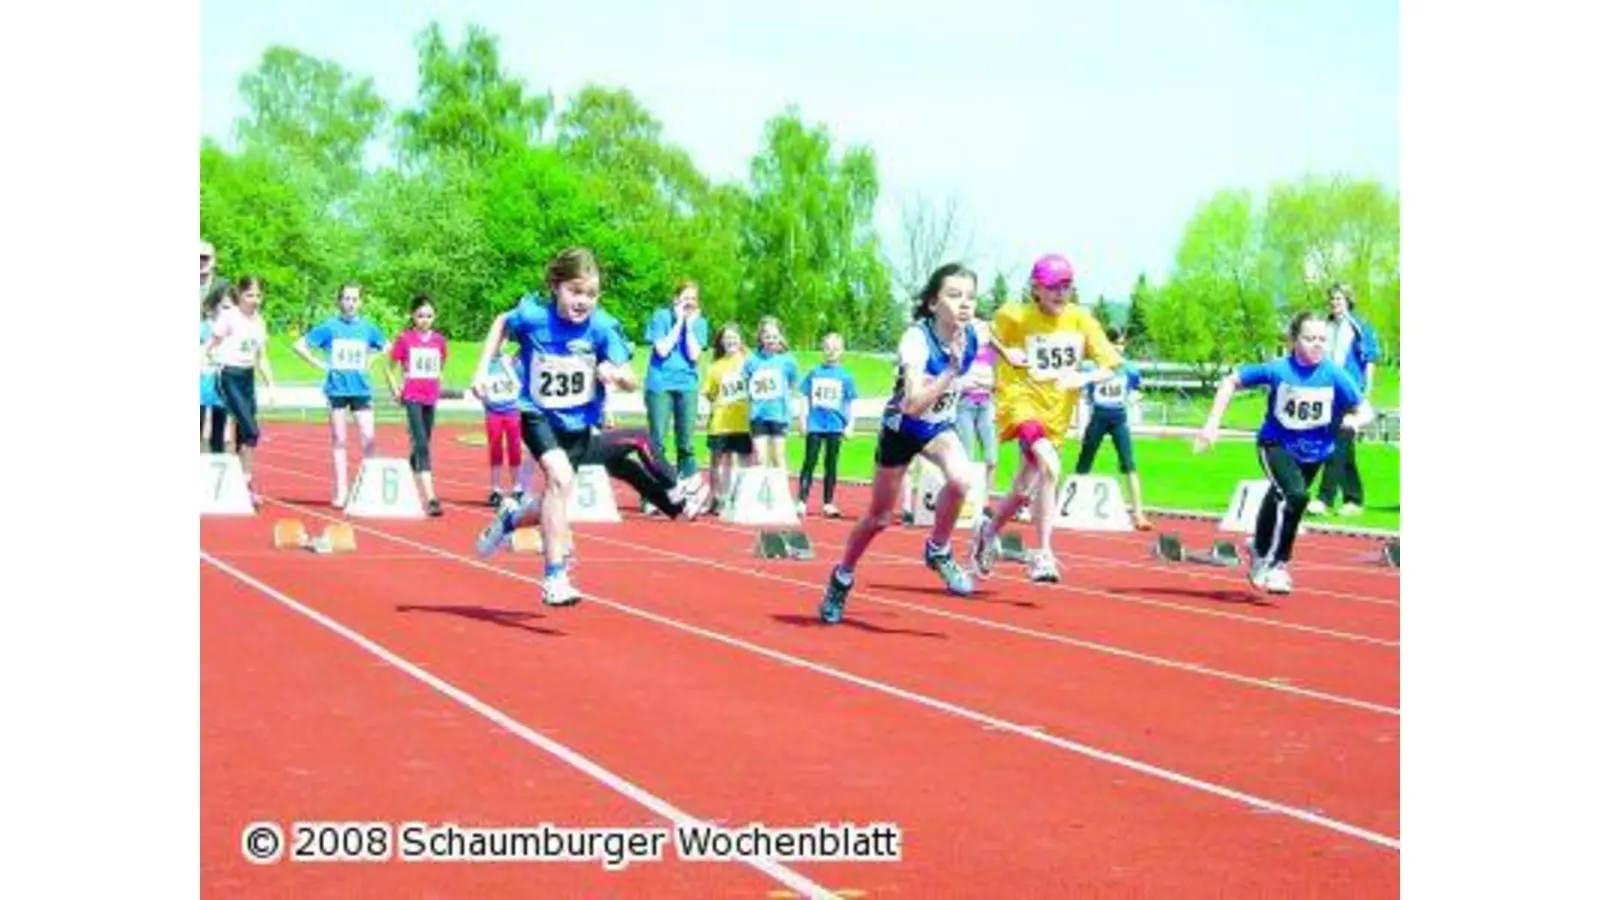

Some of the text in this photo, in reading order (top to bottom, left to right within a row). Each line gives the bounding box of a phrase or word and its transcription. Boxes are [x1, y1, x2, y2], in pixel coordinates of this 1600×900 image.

[1035, 345, 1077, 370] 553
[539, 371, 586, 397] 239
[1284, 398, 1324, 421] 469
[210, 462, 227, 500] 7
[382, 466, 399, 504] 6
[577, 468, 597, 507] 5
[756, 475, 775, 511] 4
[1061, 481, 1078, 517] 2
[1093, 482, 1110, 519] 2
